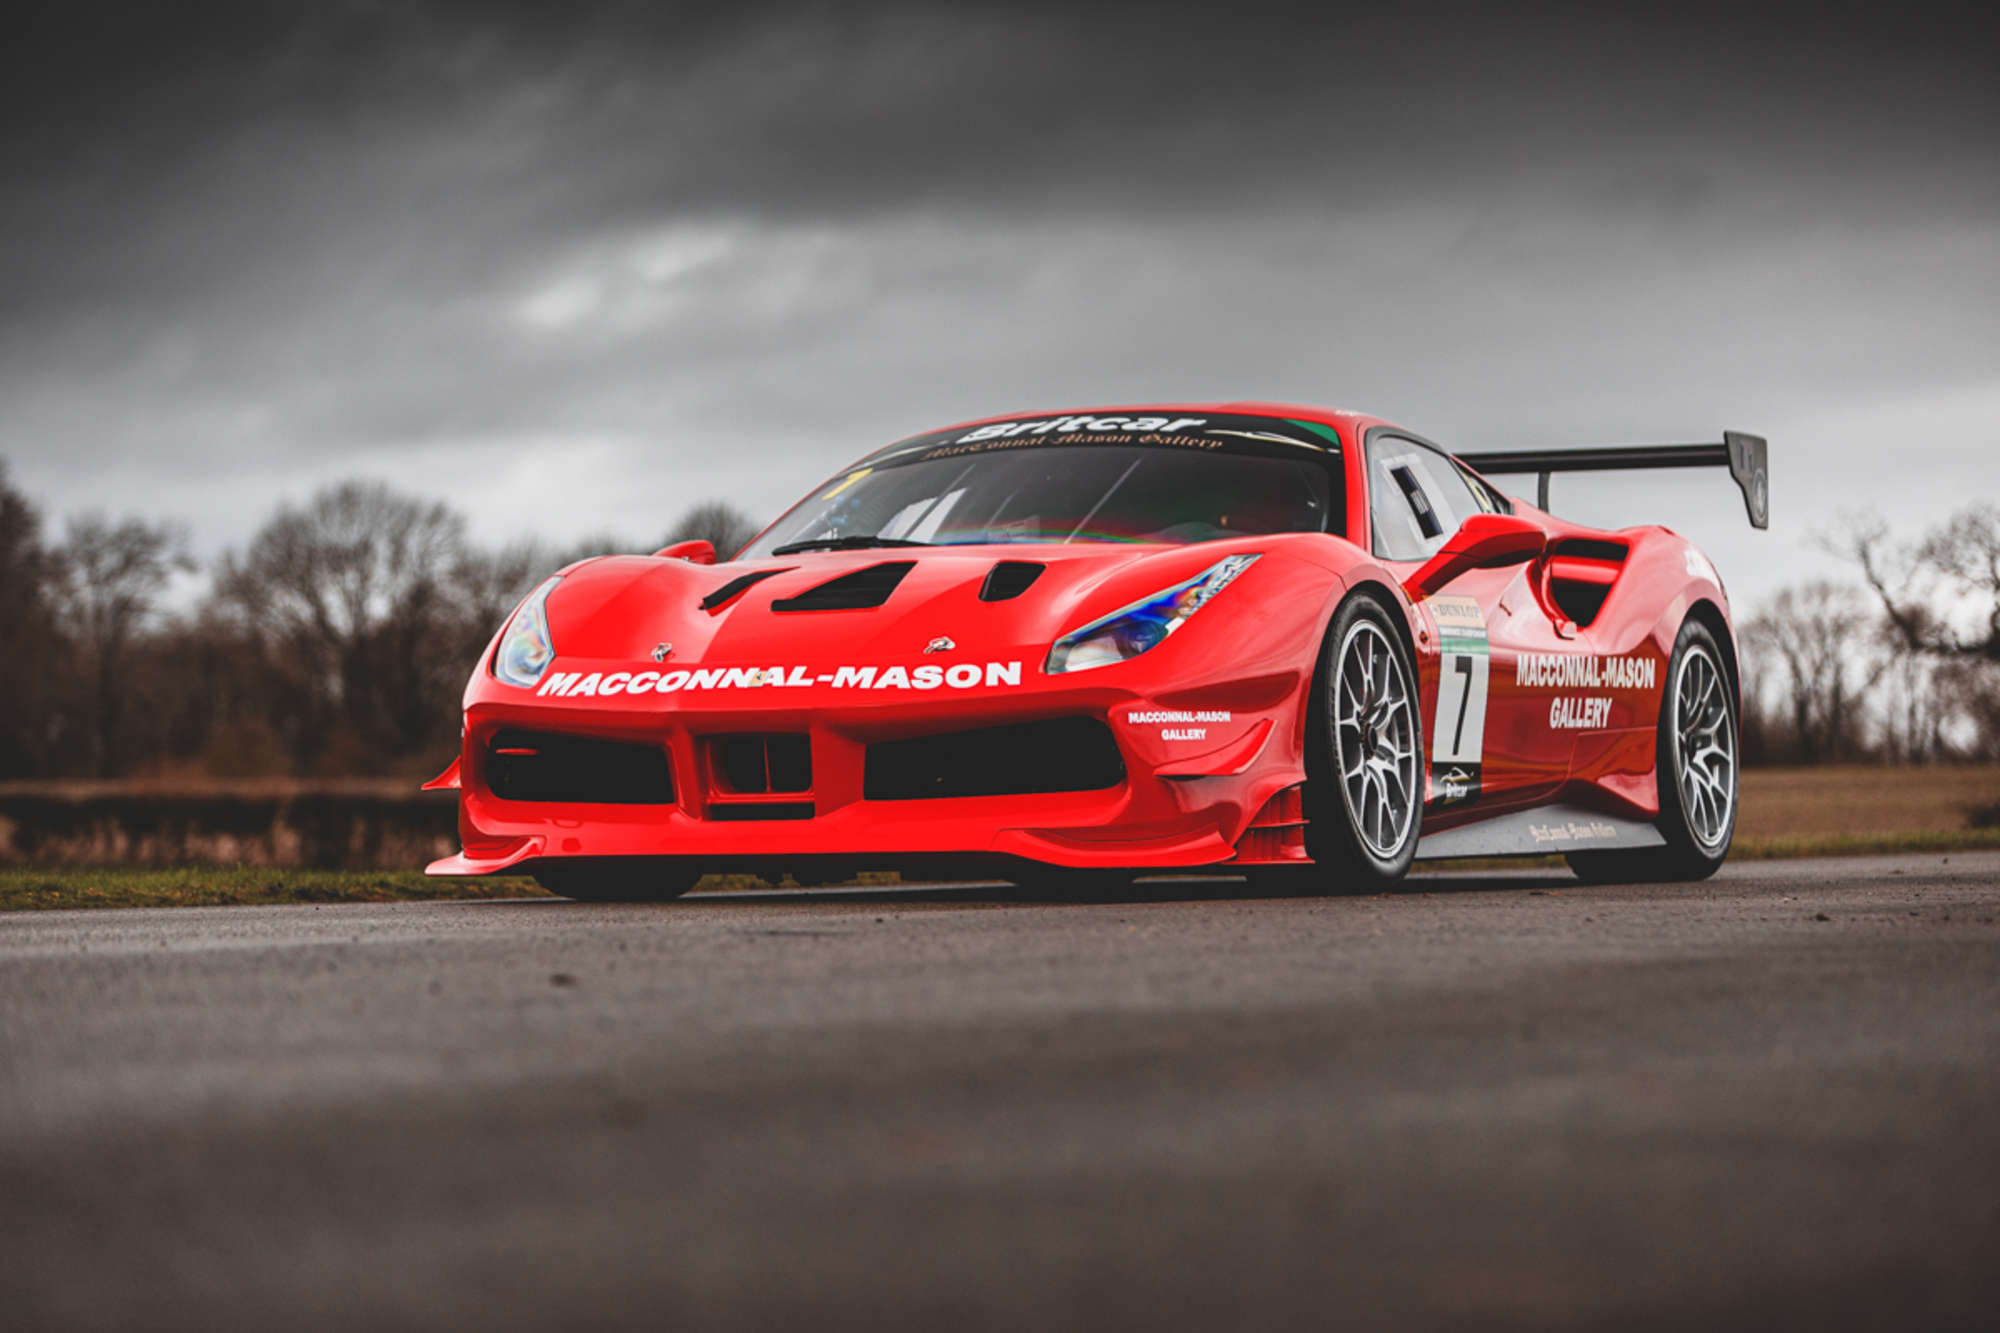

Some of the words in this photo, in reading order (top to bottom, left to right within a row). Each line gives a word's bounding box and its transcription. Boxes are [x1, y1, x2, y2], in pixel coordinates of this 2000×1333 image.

[537, 661, 1022, 697] MACCONNAL-MASON
[1516, 655, 1655, 688] MACCONNAL-MASON
[1128, 711, 1231, 723] MACCONNAL-MASON
[1451, 655, 1472, 756] 7
[1550, 697, 1612, 728] GALLERY
[1161, 729, 1206, 740] GALLERY
